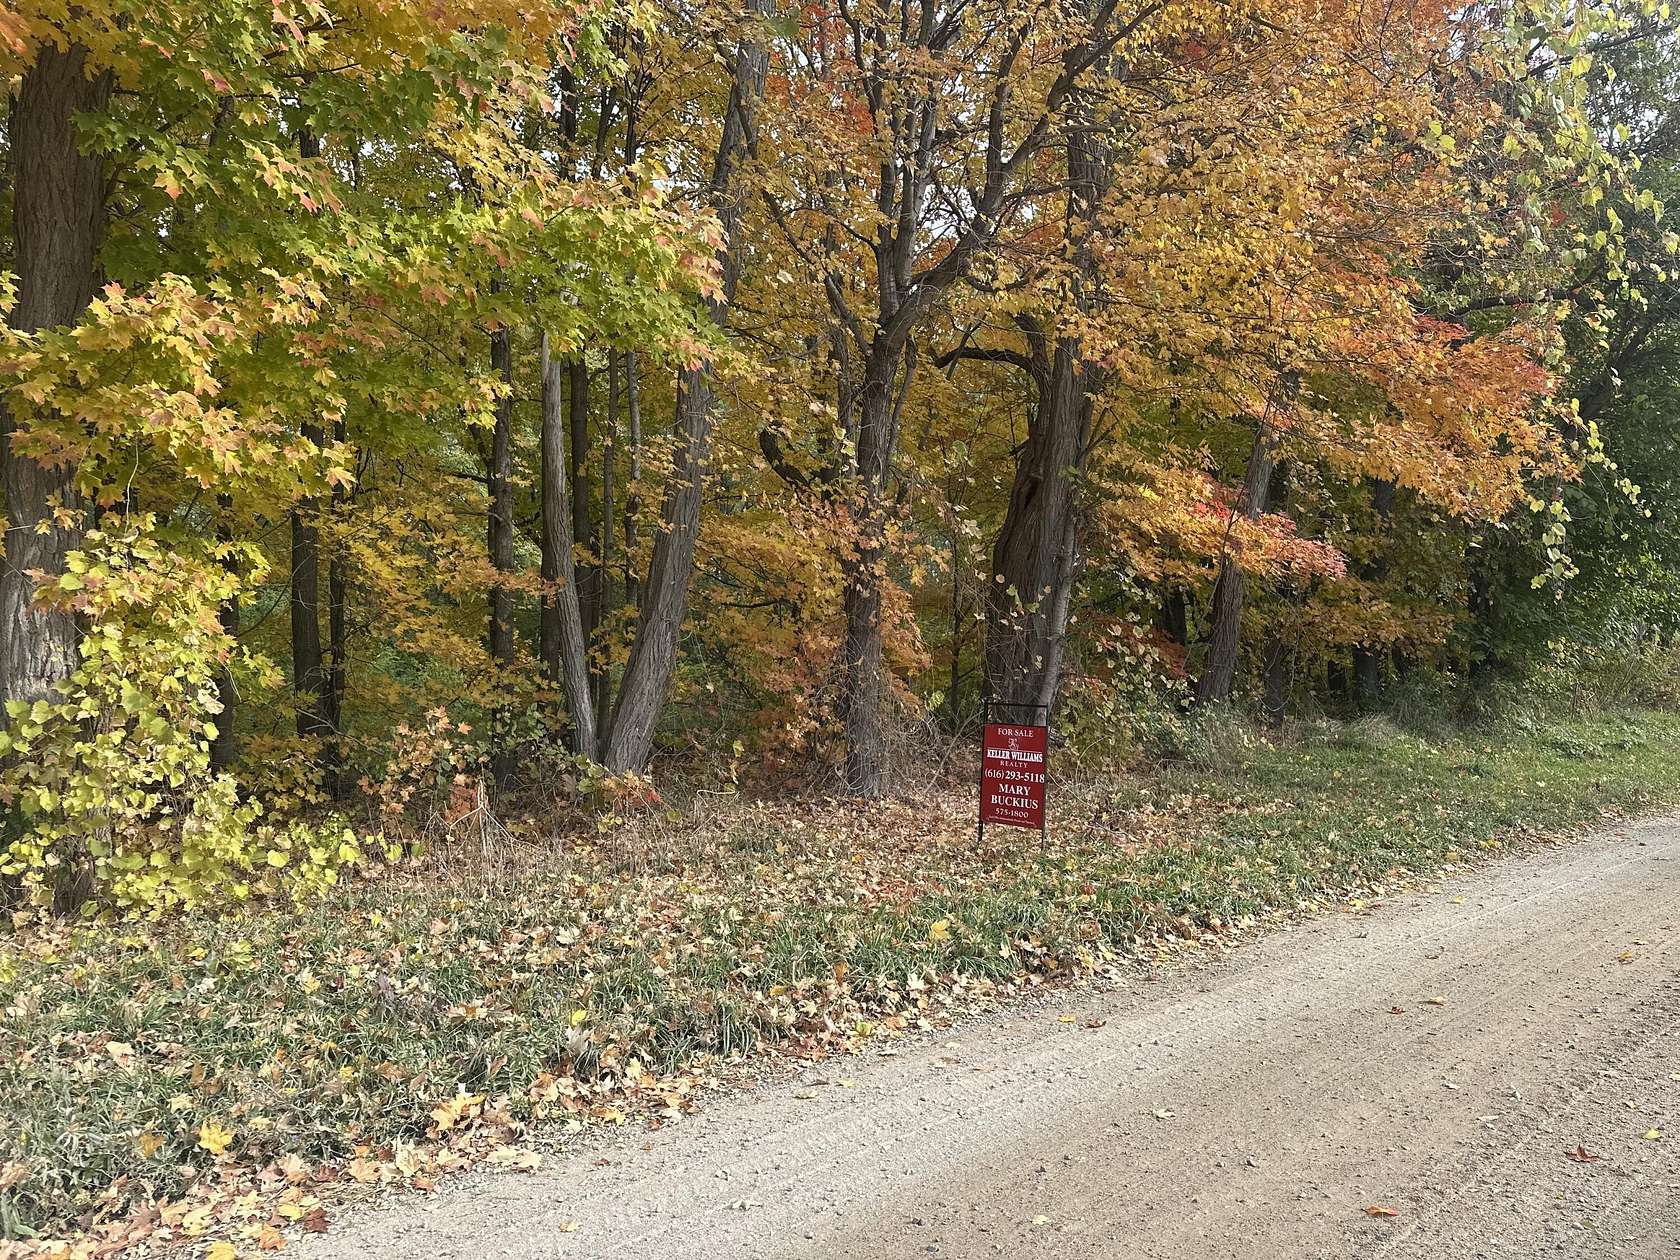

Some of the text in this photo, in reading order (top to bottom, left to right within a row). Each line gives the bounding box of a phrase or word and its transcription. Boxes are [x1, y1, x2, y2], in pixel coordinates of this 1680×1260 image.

[998, 727, 1034, 738] FOR SALE
[987, 749, 1043, 763] KELLER WILLIAMS
[1000, 760, 1029, 768] REALTY
[985, 768, 1045, 783] (616) 293-5118
[999, 784, 1031, 796] MARY
[991, 795, 1038, 809] BUCKIUS
